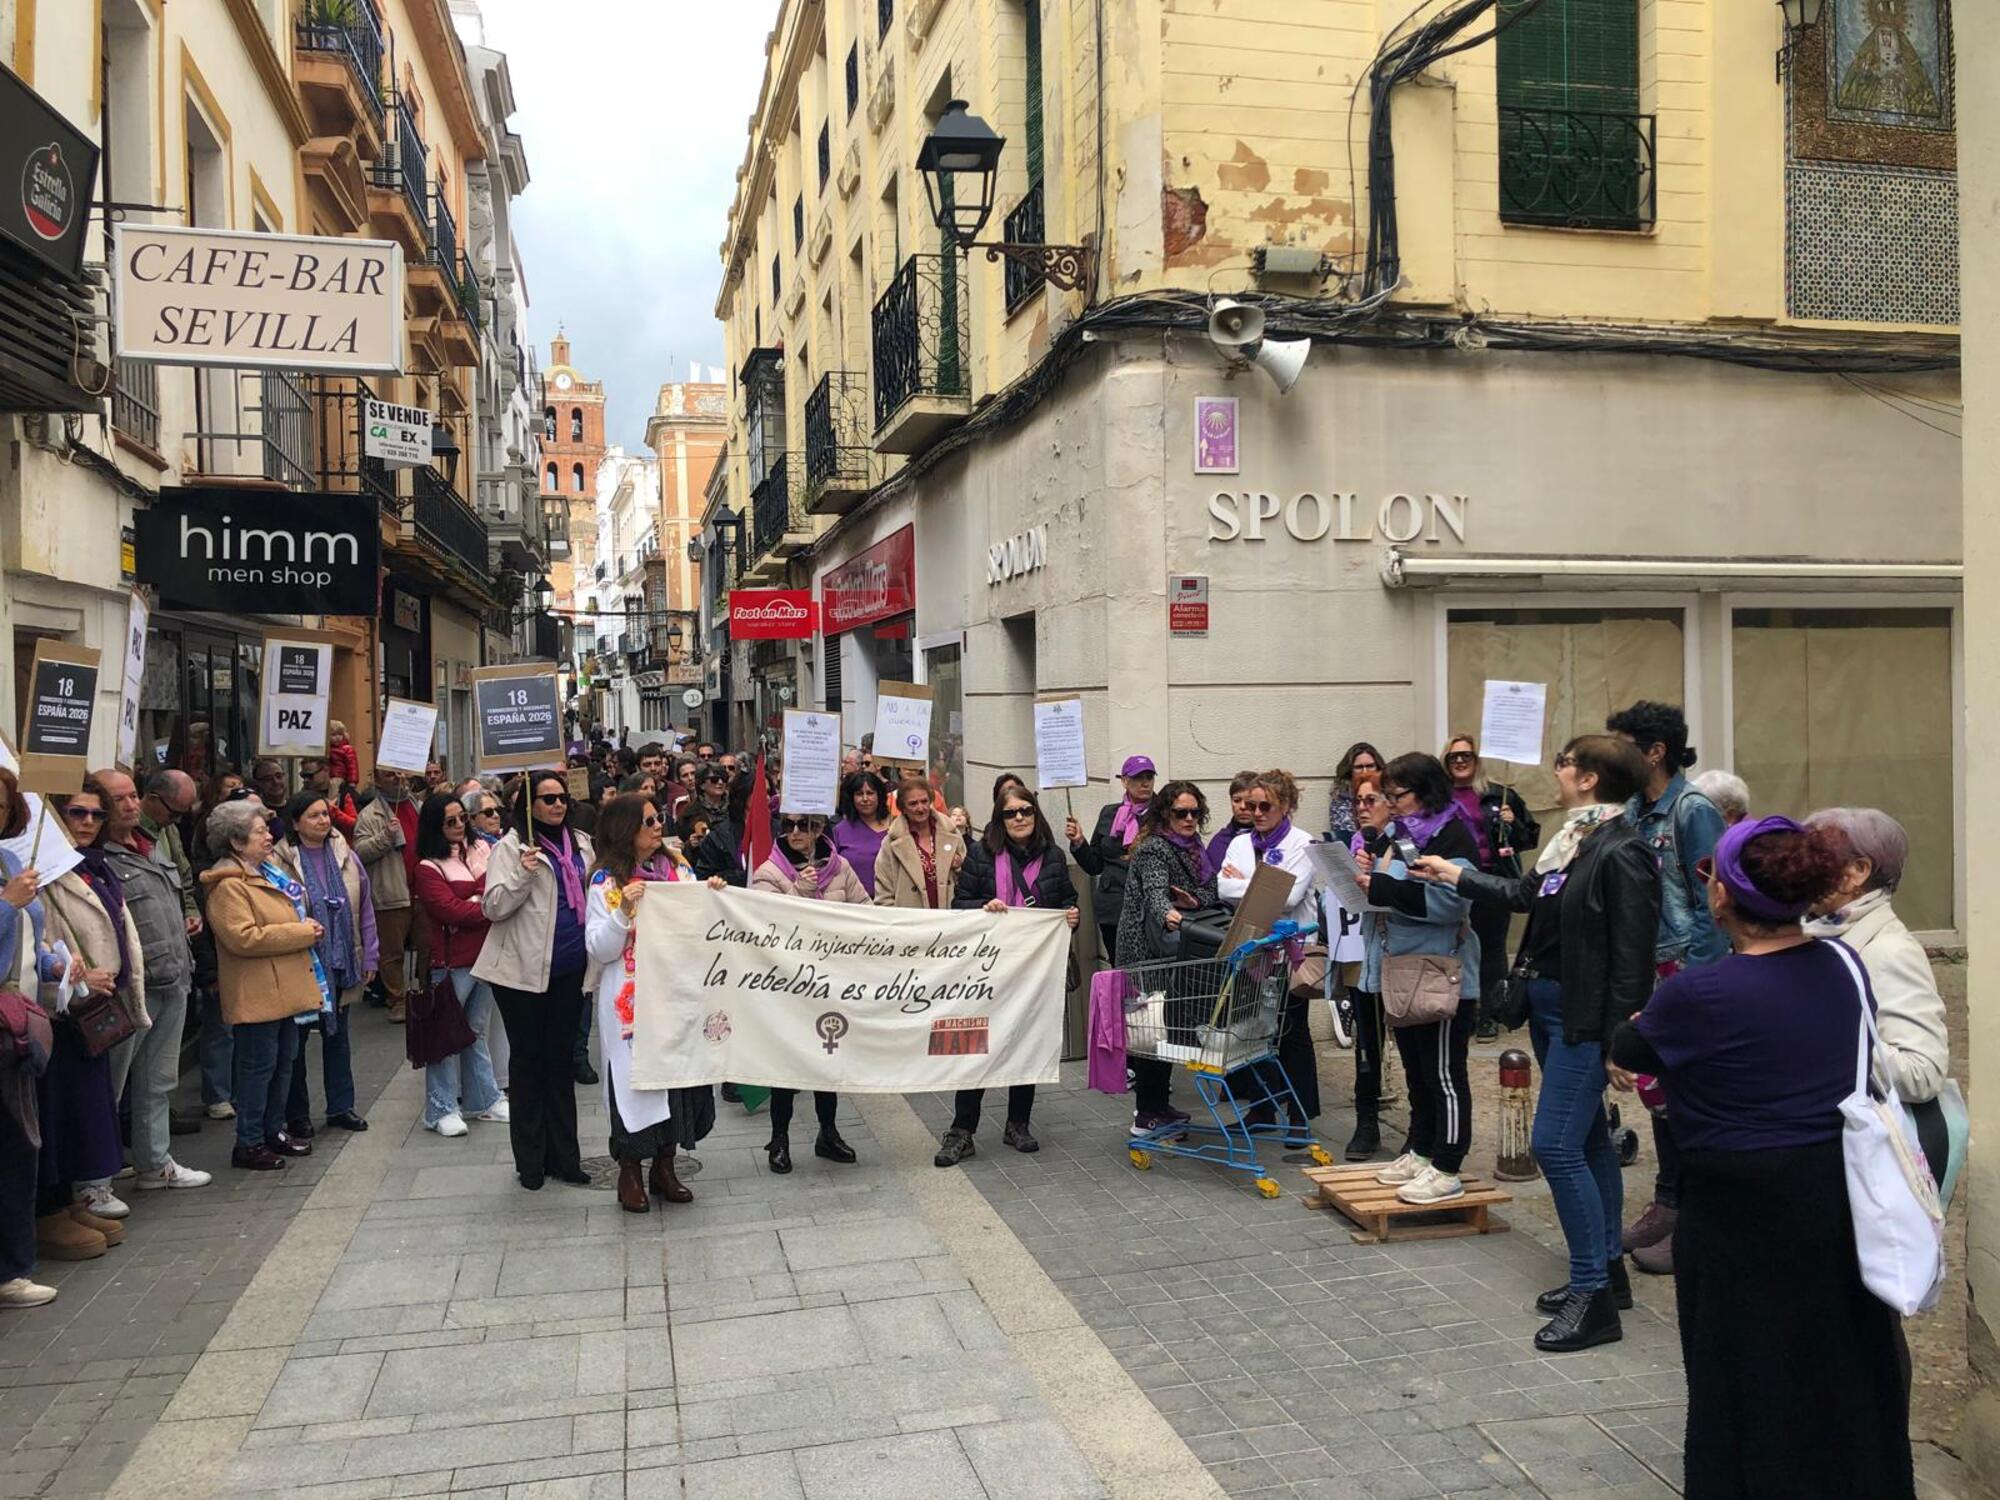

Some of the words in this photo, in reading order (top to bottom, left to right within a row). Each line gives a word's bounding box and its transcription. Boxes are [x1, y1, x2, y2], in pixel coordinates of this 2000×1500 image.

[32, 161, 67, 202] Estrella
[31, 183, 62, 222] Galicia
[129, 243, 386, 296] CAFE-BAR
[153, 305, 359, 353] SEVILLA
[369, 402, 385, 419] SE
[388, 405, 429, 427] VENDE
[1207, 491, 1468, 543] SPOLON
[180, 514, 358, 565] himm
[988, 523, 1047, 586] SPOLON
[208, 567, 263, 583] men
[271, 566, 331, 589] shop
[734, 607, 760, 620] Foot
[762, 607, 776, 619] on
[778, 607, 808, 619] Mars
[293, 654, 305, 665] 18
[57, 677, 74, 698] 18
[507, 689, 528, 706] 18
[37, 703, 67, 718] ESPAÑA
[68, 707, 89, 720] 2026
[278, 709, 312, 730] PAZ
[487, 711, 526, 726] ESPAÑA
[528, 710, 552, 722] 2026
[705, 919, 781, 948] Cuando
[785, 925, 803, 951] la
[809, 932, 895, 961] injusticia
[899, 947, 919, 959] se
[925, 932, 968, 959] hace
[973, 933, 1001, 972] ley
[703, 952, 729, 987] la
[738, 965, 830, 999] rebeldía
[840, 981, 867, 1001] es
[874, 968, 994, 1014] obligación
[945, 1016, 988, 1028] MACHISMO
[928, 1029, 989, 1055] MATA
